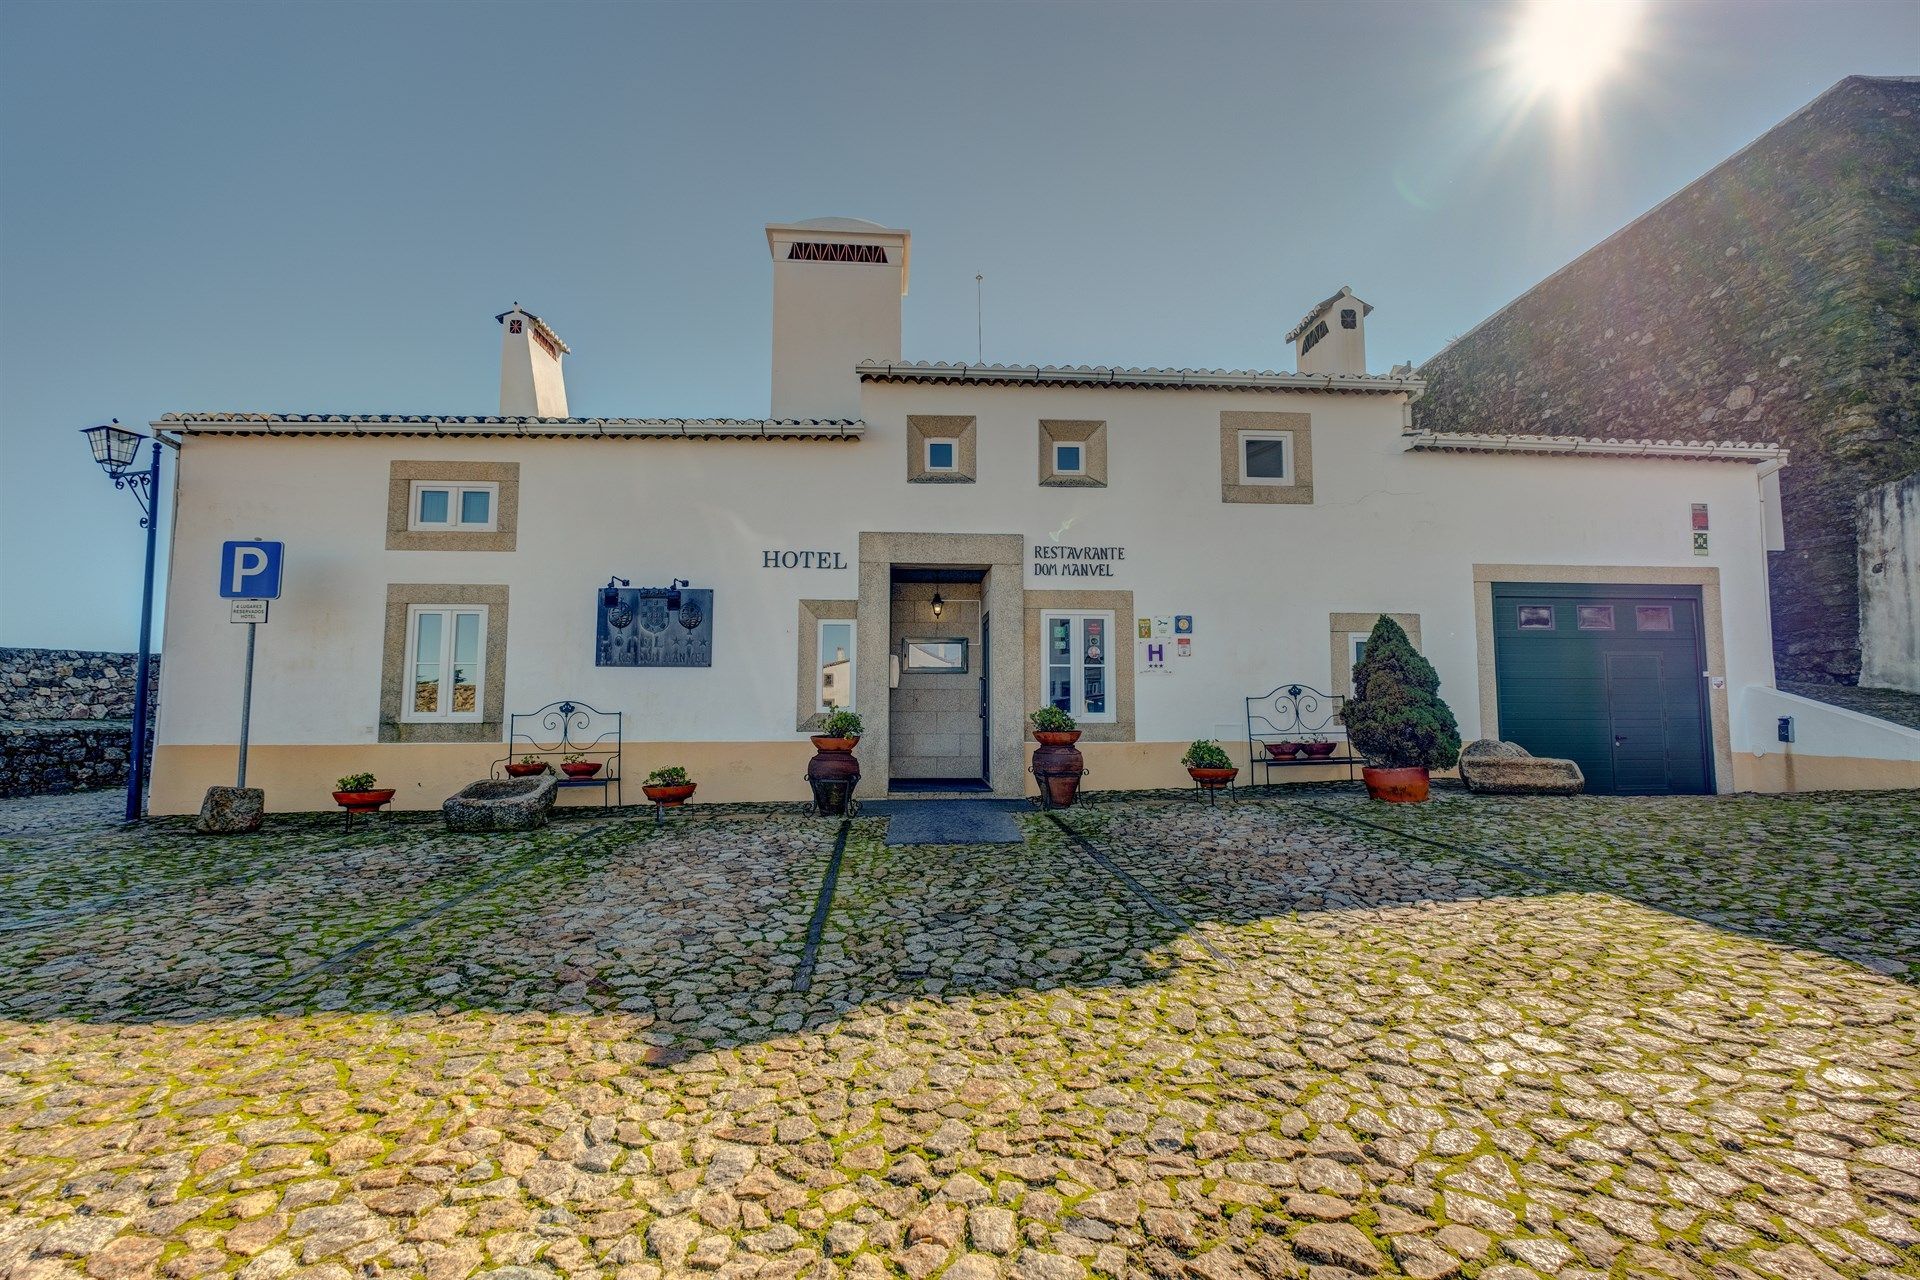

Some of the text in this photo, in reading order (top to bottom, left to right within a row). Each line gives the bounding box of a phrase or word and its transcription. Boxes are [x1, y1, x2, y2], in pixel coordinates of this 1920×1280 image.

[762, 550, 848, 569] HOTEL
[1034, 545, 1125, 560] RESTAVRANTE
[232, 547, 268, 592] P
[1034, 563, 1114, 577] DOM MANVEL
[1148, 644, 1163, 661] H
